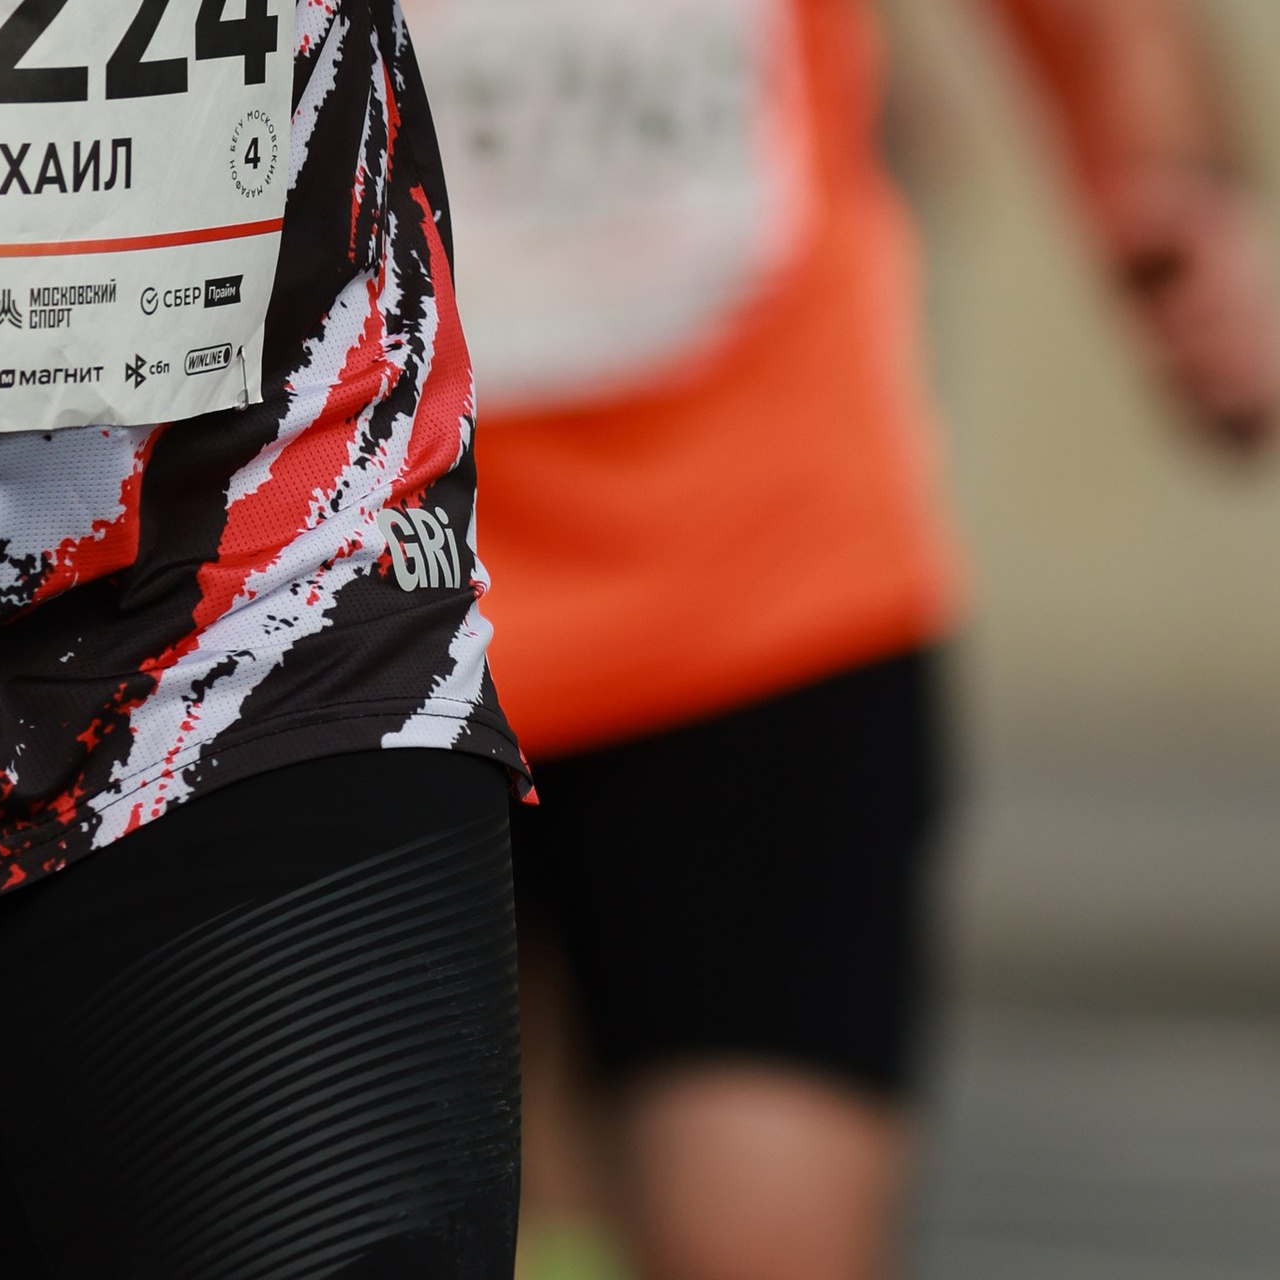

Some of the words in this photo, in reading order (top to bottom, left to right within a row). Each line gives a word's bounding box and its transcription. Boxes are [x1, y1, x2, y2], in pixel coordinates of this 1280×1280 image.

[244, 137, 261, 169] 4
[229, 159, 263, 198] МАРАФОН
[29, 279, 117, 307] МОСКОВСКИЙ
[163, 286, 202, 308] СБЕР
[208, 283, 236, 301] Прайм
[29, 308, 72, 329] СПОРТ
[149, 360, 170, 375] сбп
[188, 350, 223, 370] WINLINE
[19, 366, 104, 386] магнит
